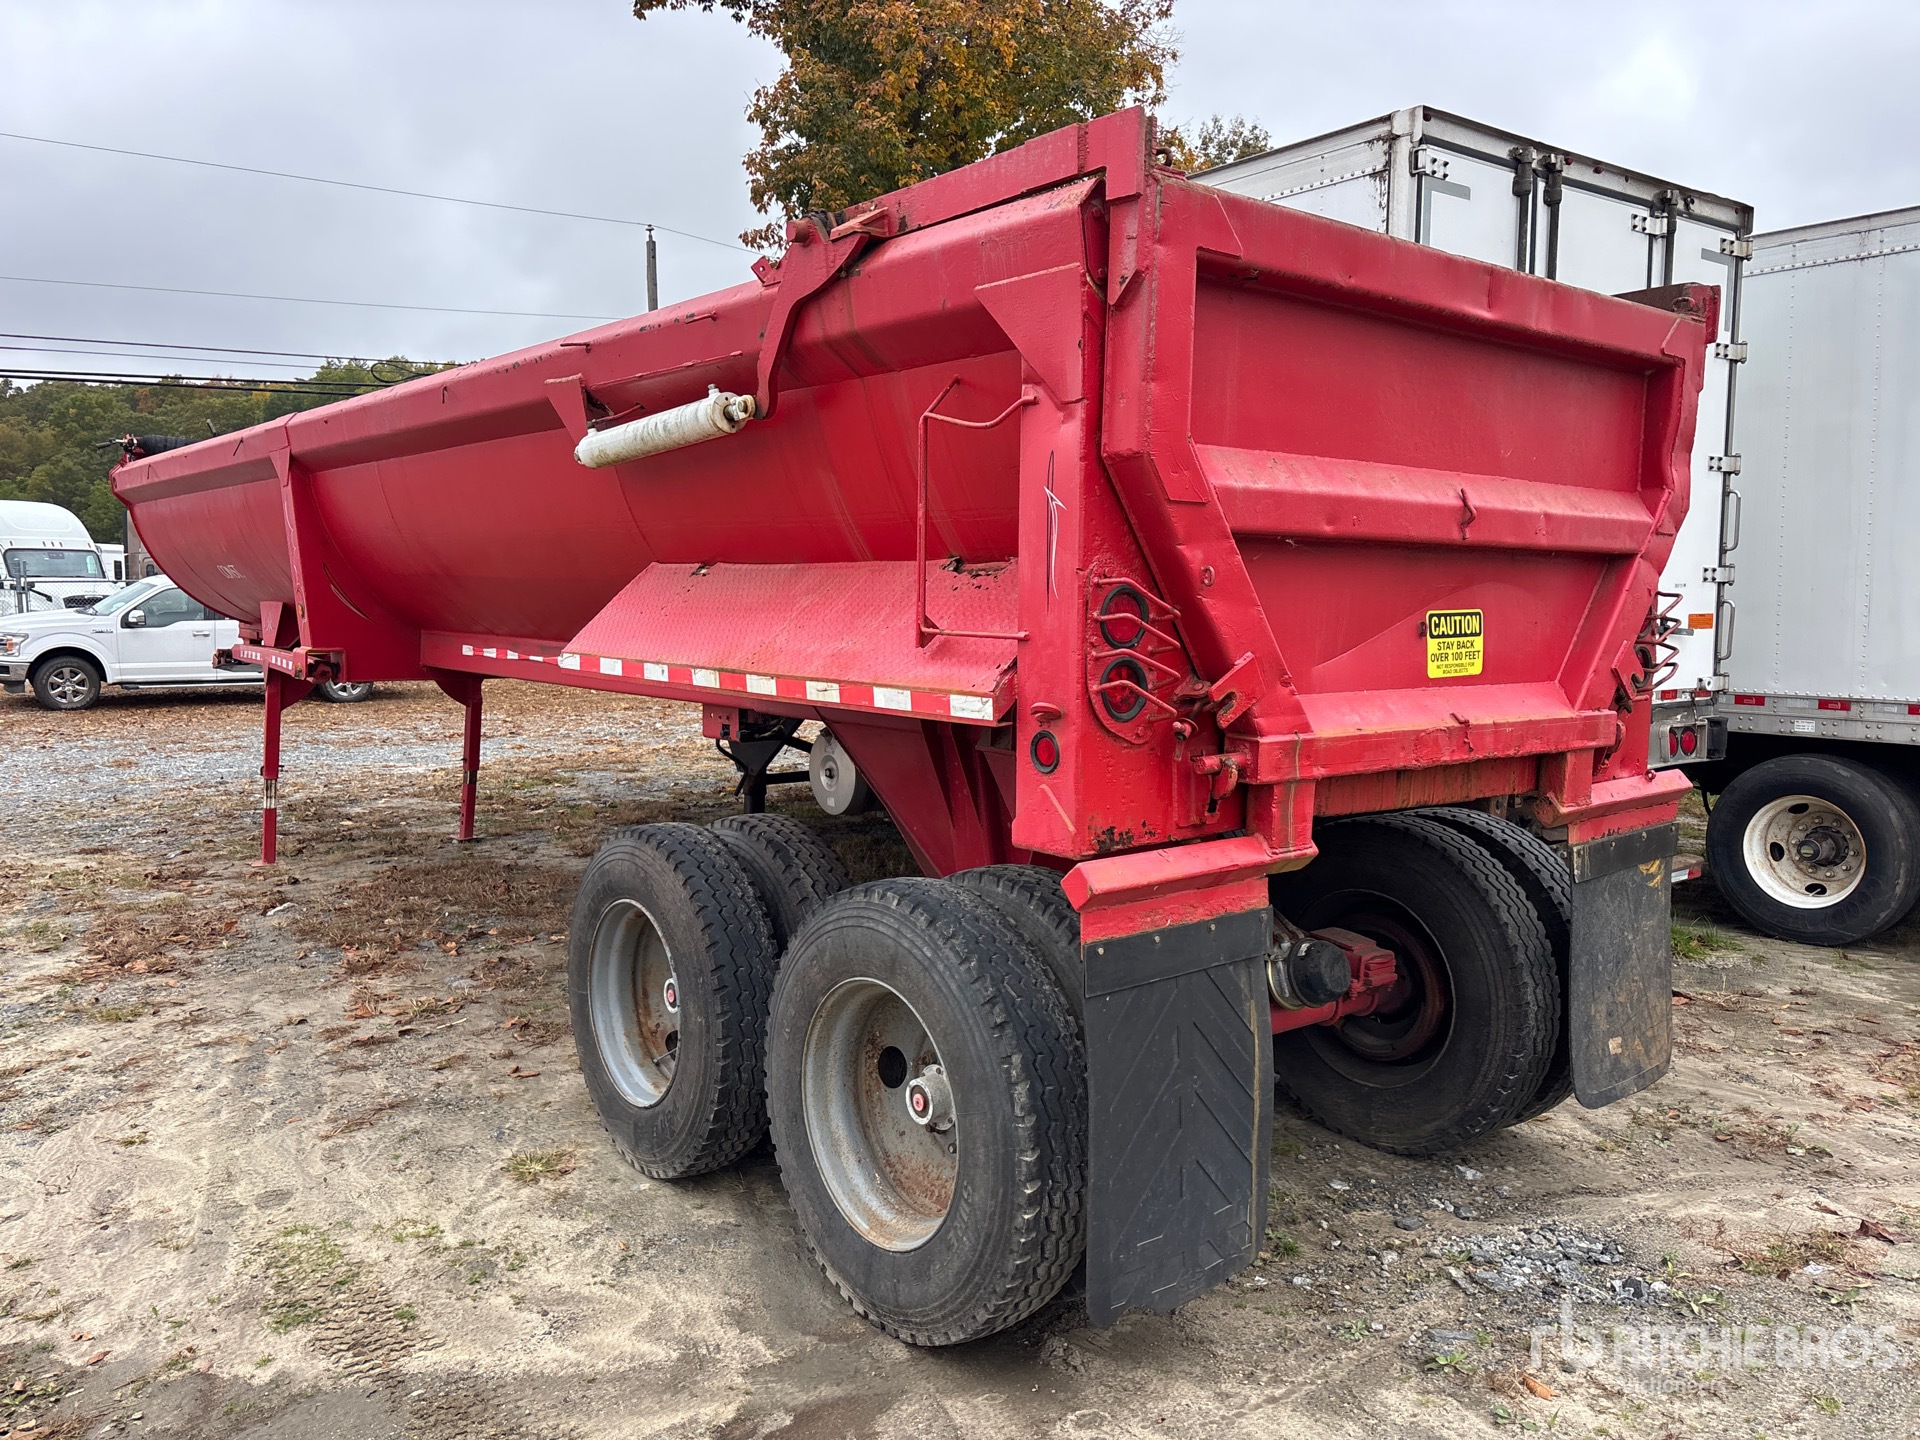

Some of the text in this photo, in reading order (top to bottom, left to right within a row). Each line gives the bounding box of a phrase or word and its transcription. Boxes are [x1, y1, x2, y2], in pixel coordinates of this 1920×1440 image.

[1431, 615, 1480, 635] CAUTION
[1437, 640, 1475, 651] STAY BACK
[1430, 650, 1481, 662] OVER 100 FEET
